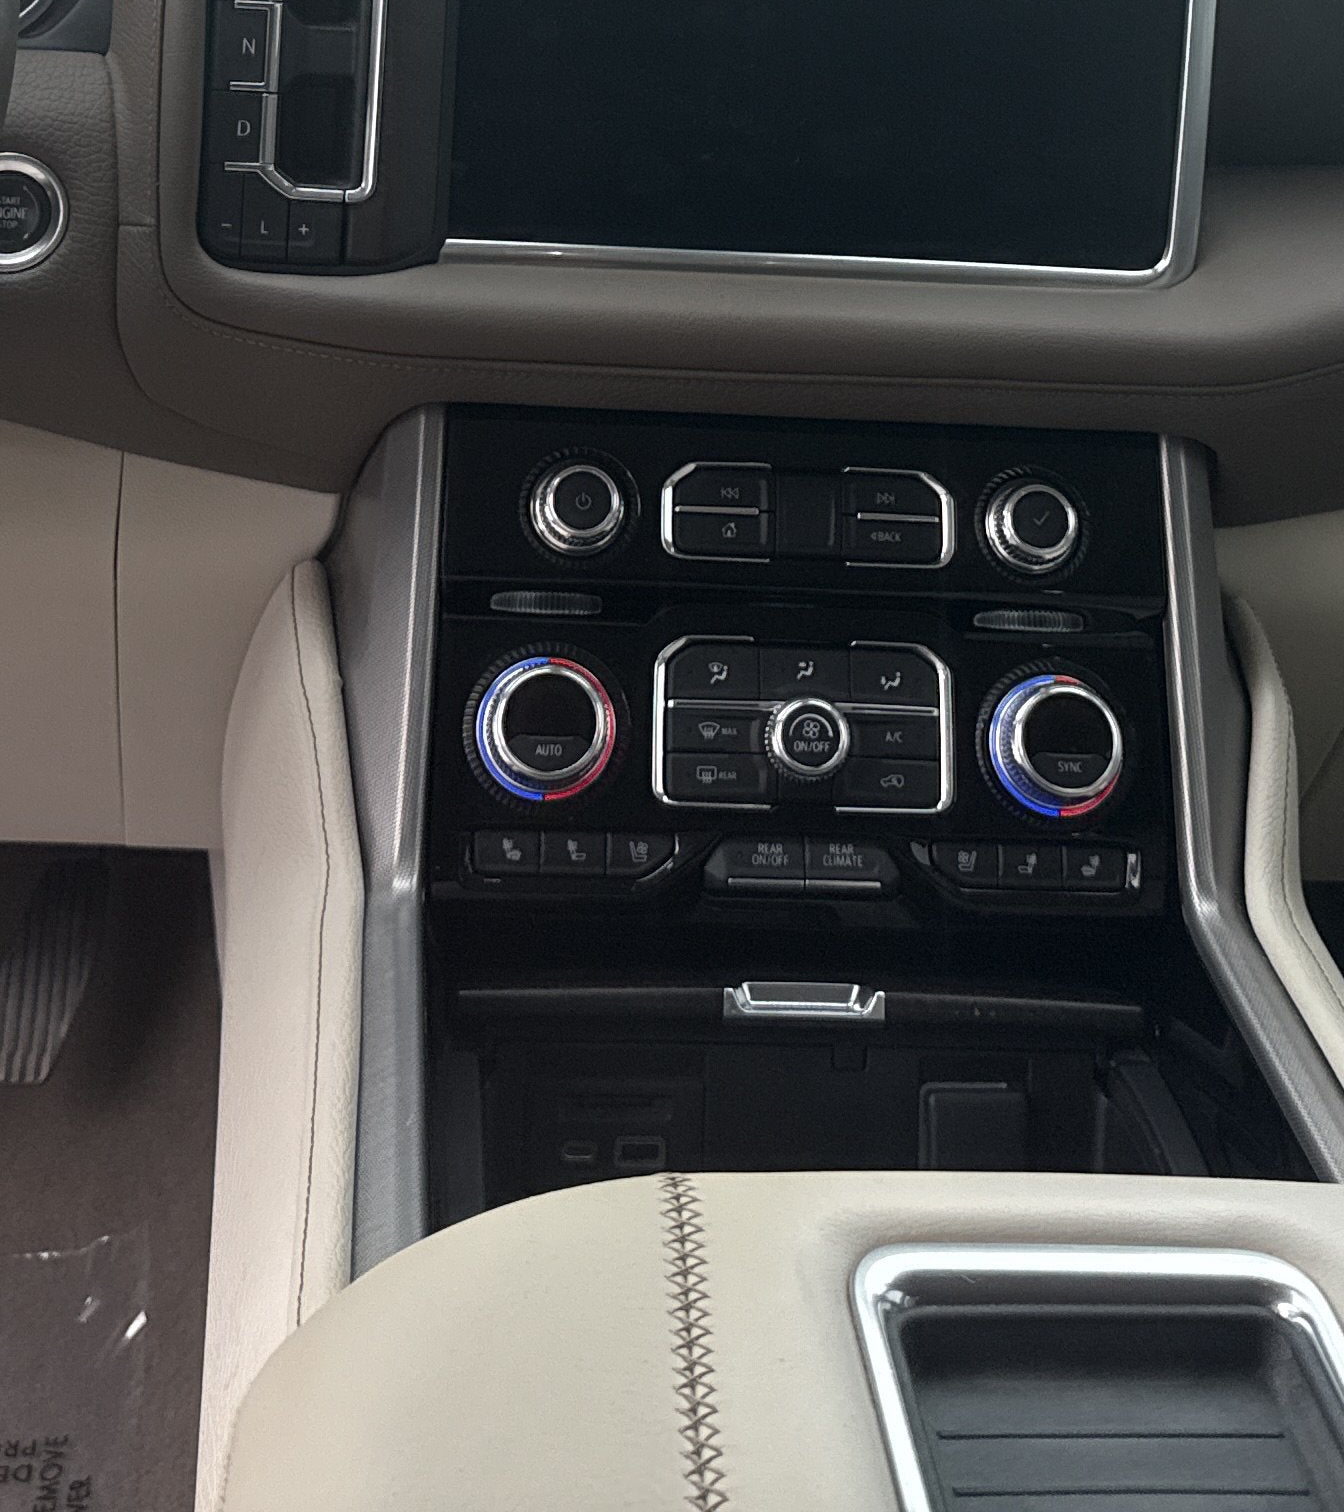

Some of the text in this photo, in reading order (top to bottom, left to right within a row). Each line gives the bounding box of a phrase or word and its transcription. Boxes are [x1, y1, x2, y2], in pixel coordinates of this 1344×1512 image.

[242, 38, 256, 55] N
[236, 120, 251, 137] D
[260, 220, 269, 234] L
[877, 530, 902, 542] BACK
[721, 727, 738, 736] MAX
[885, 731, 902, 743] A/C
[535, 743, 563, 757] AUTO
[793, 740, 830, 753] ON/OFF
[1057, 760, 1083, 773] SYNC
[718, 770, 737, 780] REAR
[757, 843, 783, 854] REAR
[829, 843, 855, 855] REAR
[751, 854, 789, 866] ON/OFF
[822, 854, 864, 867] CLIMATE
